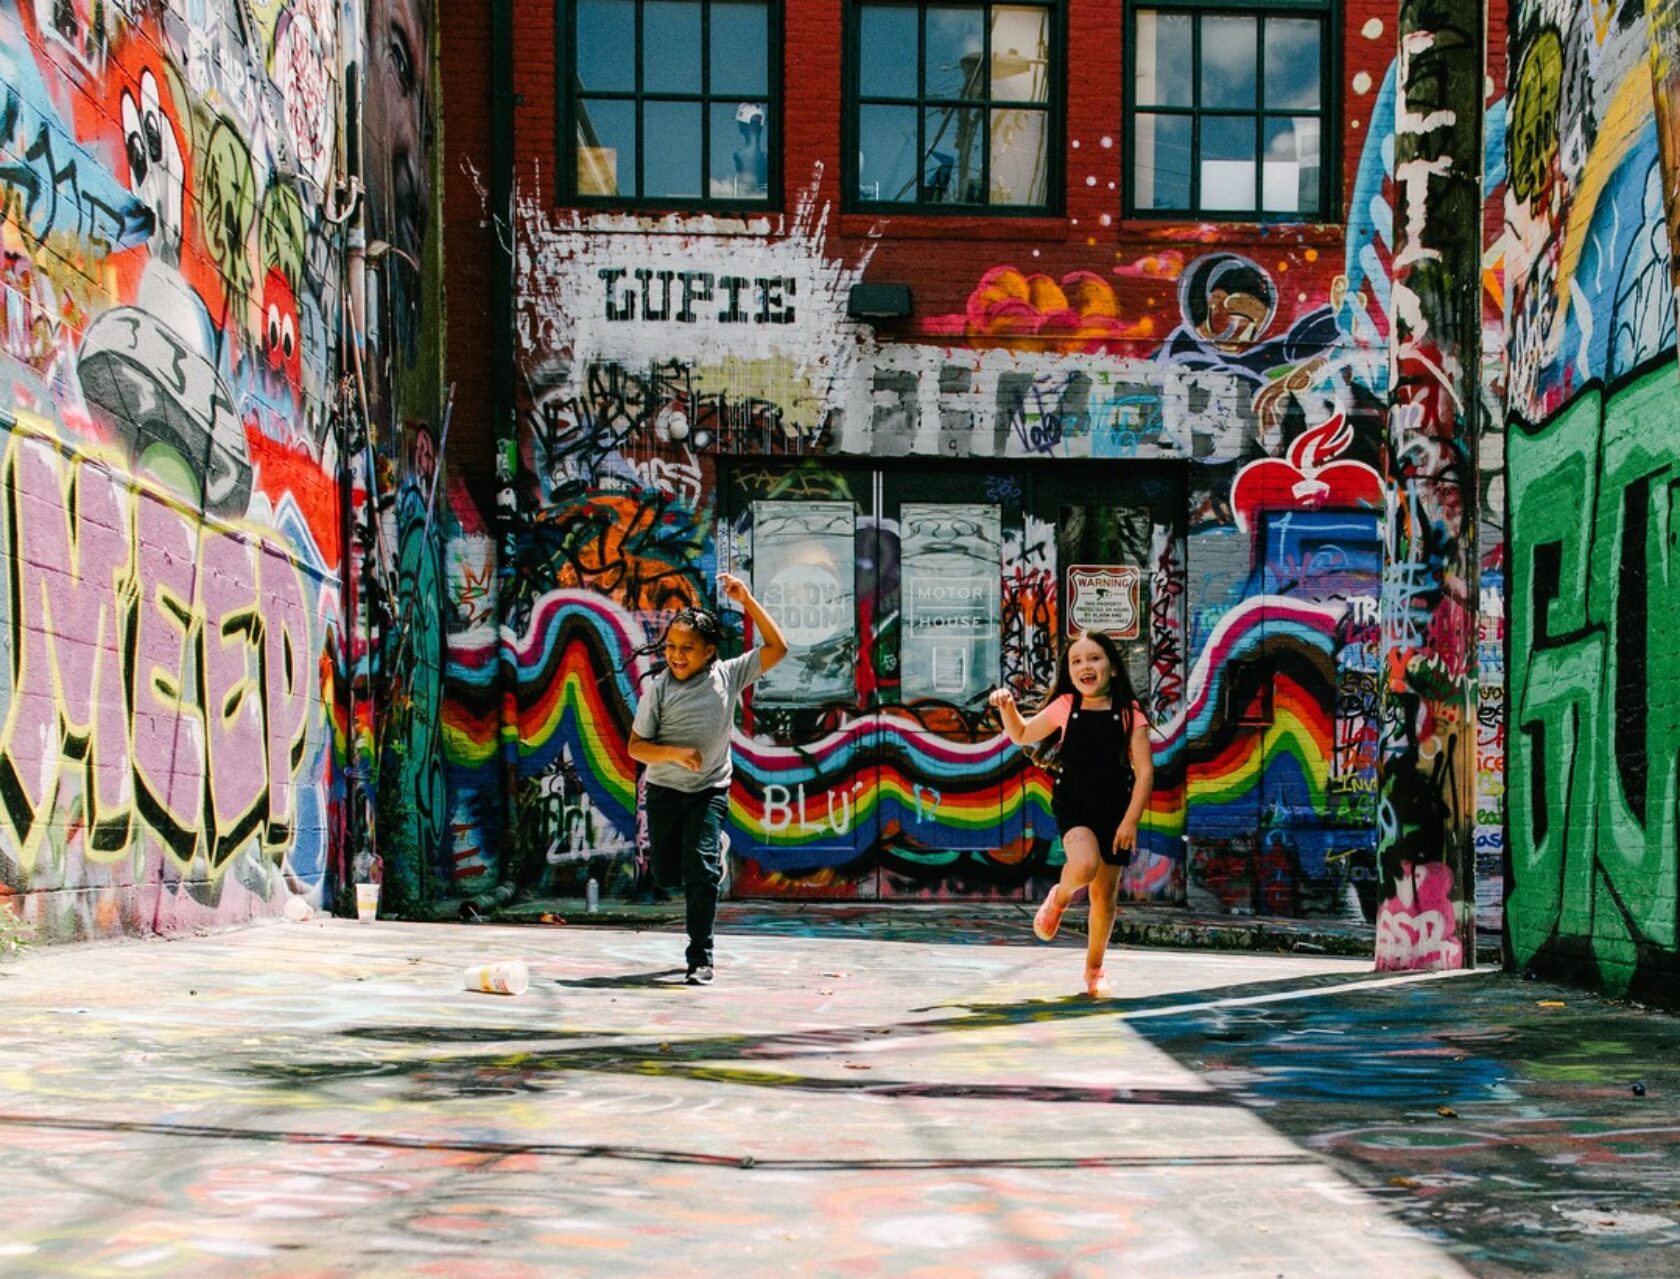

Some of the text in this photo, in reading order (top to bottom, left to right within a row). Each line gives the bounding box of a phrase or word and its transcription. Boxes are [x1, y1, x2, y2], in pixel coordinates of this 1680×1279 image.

[1078, 578, 1129, 588] WARNING
[765, 582, 844, 606] SHOW
[917, 586, 985, 600] MOTOR
[918, 615, 984, 629] HOUSE
